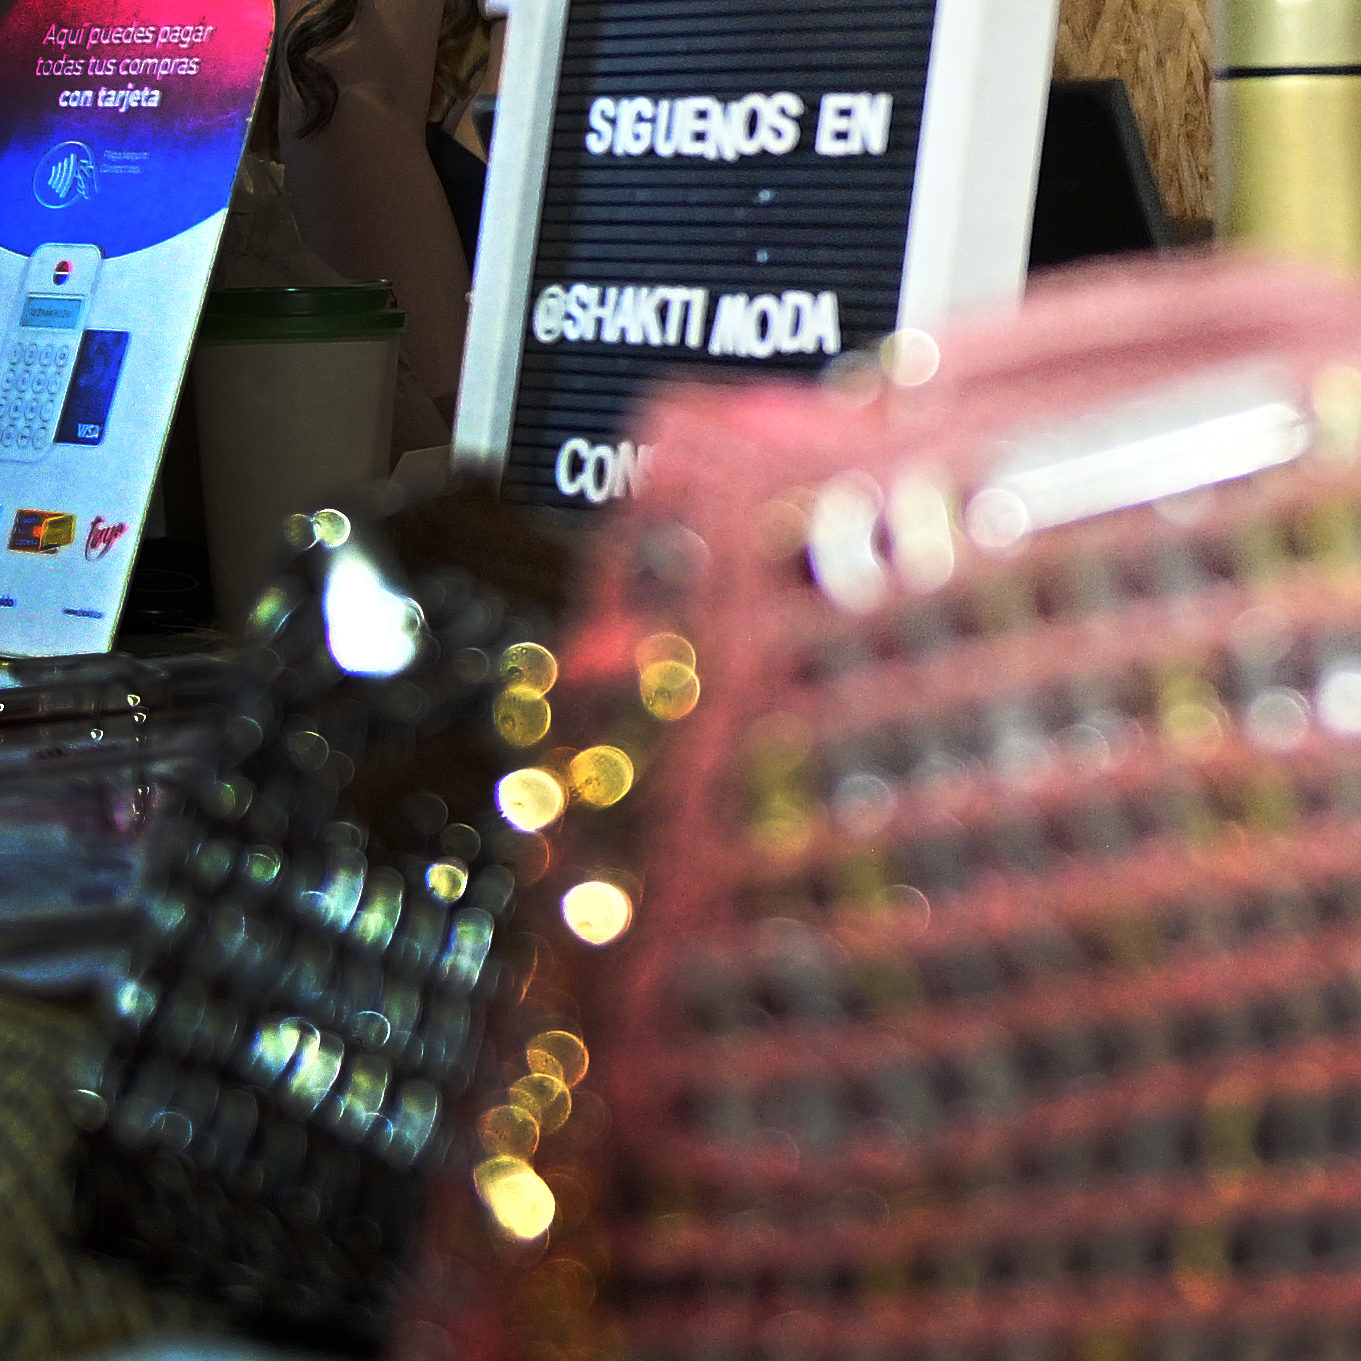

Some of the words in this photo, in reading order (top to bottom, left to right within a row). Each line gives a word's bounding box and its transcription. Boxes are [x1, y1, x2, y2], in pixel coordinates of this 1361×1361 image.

[86, 21, 156, 50] puedes
[155, 24, 214, 49] pagar
[35, 54, 86, 76] todas
[87, 56, 117, 76] tus
[118, 57, 200, 80] compras
[58, 89, 93, 107] con
[97, 82, 162, 113] tarjeta
[586, 93, 803, 160] SIGUENOS
[814, 92, 893, 155] EN
[532, 284, 708, 347] @SHAKTI
[708, 290, 840, 357] MODA
